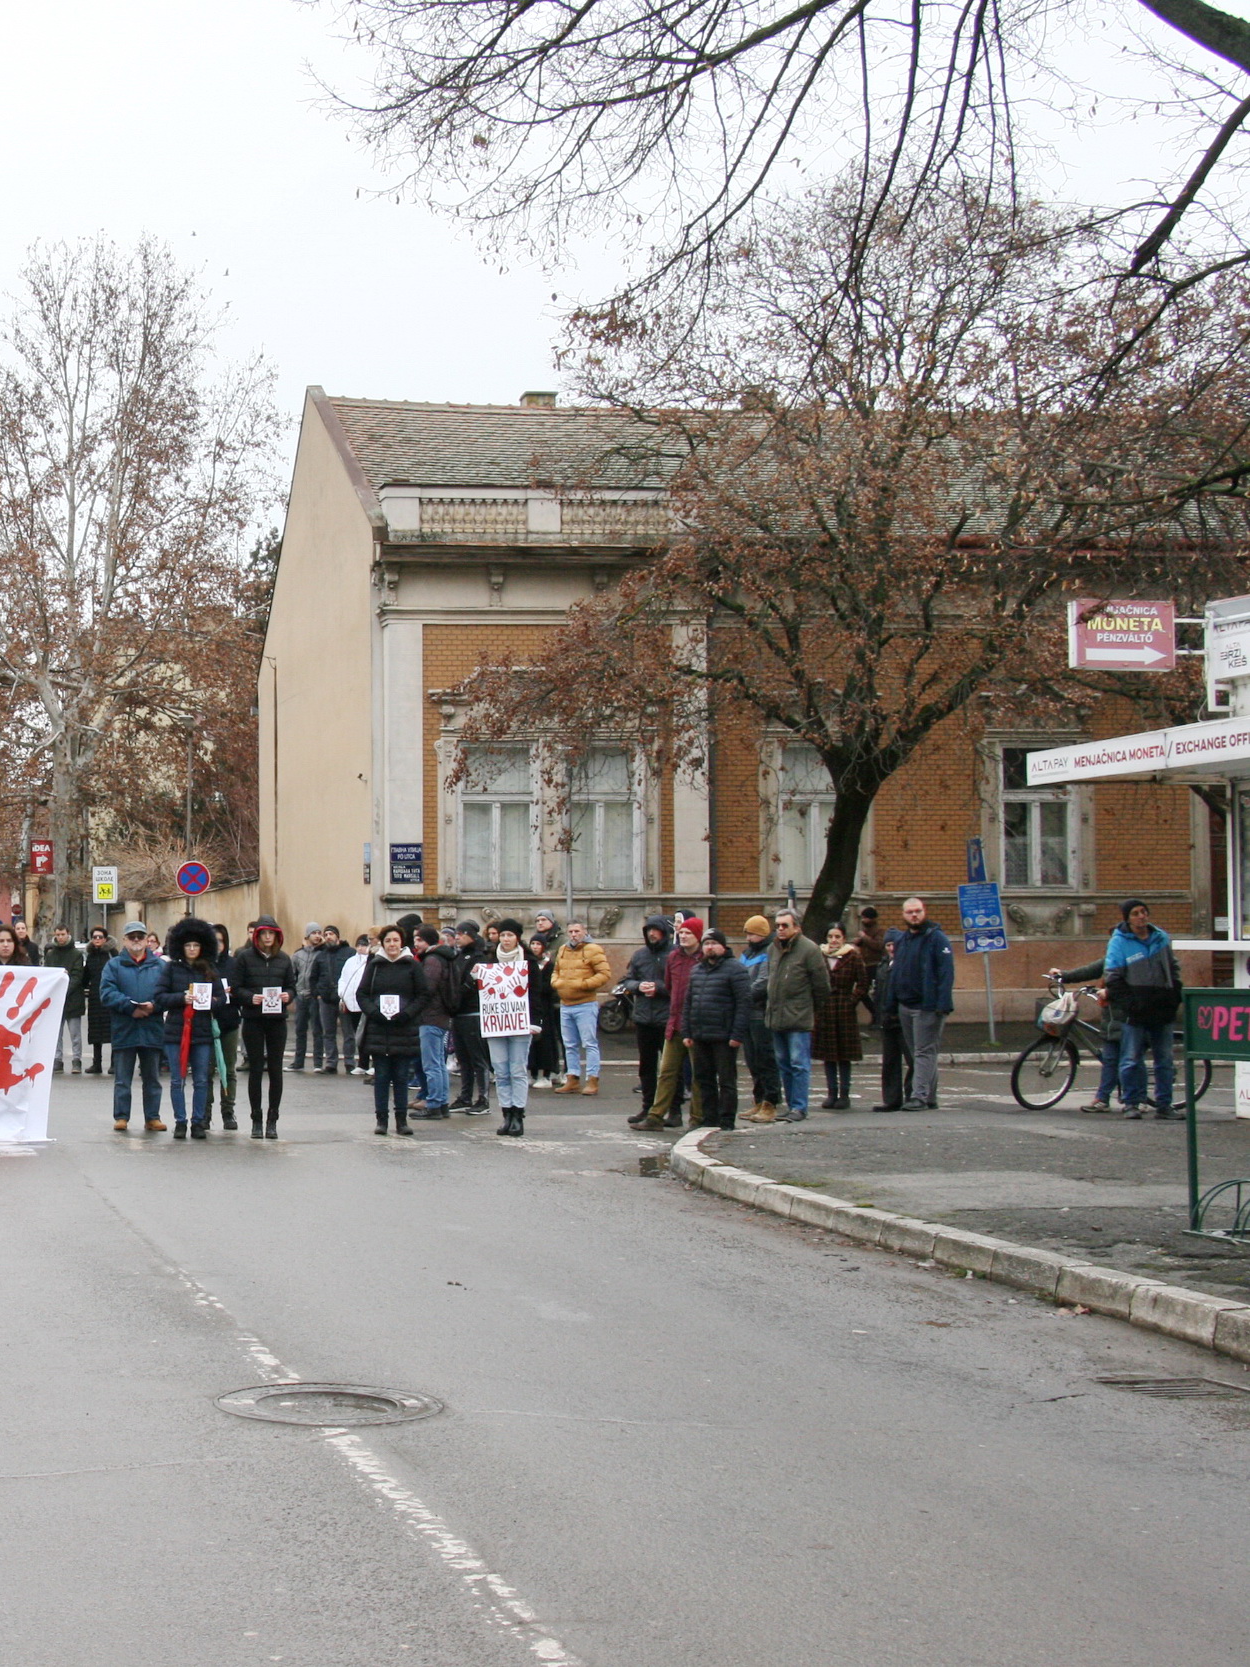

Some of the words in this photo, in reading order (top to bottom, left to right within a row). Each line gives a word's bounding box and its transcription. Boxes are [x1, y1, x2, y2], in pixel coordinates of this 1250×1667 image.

[1087, 617, 1163, 631] MONETA
[1096, 632, 1153, 643] PÉNZVÁLTÓ
[1031, 757, 1069, 772] ALTAPAY
[1074, 749, 1127, 768] MENJAČNICA
[1129, 745, 1165, 761] MONETA
[1176, 735, 1227, 755] EXCHANGE
[482, 1002, 499, 1014] RUKE
[500, 1002, 510, 1013] SU
[510, 1001, 526, 1012] VAM
[483, 1012, 529, 1033] KRVAVE!
